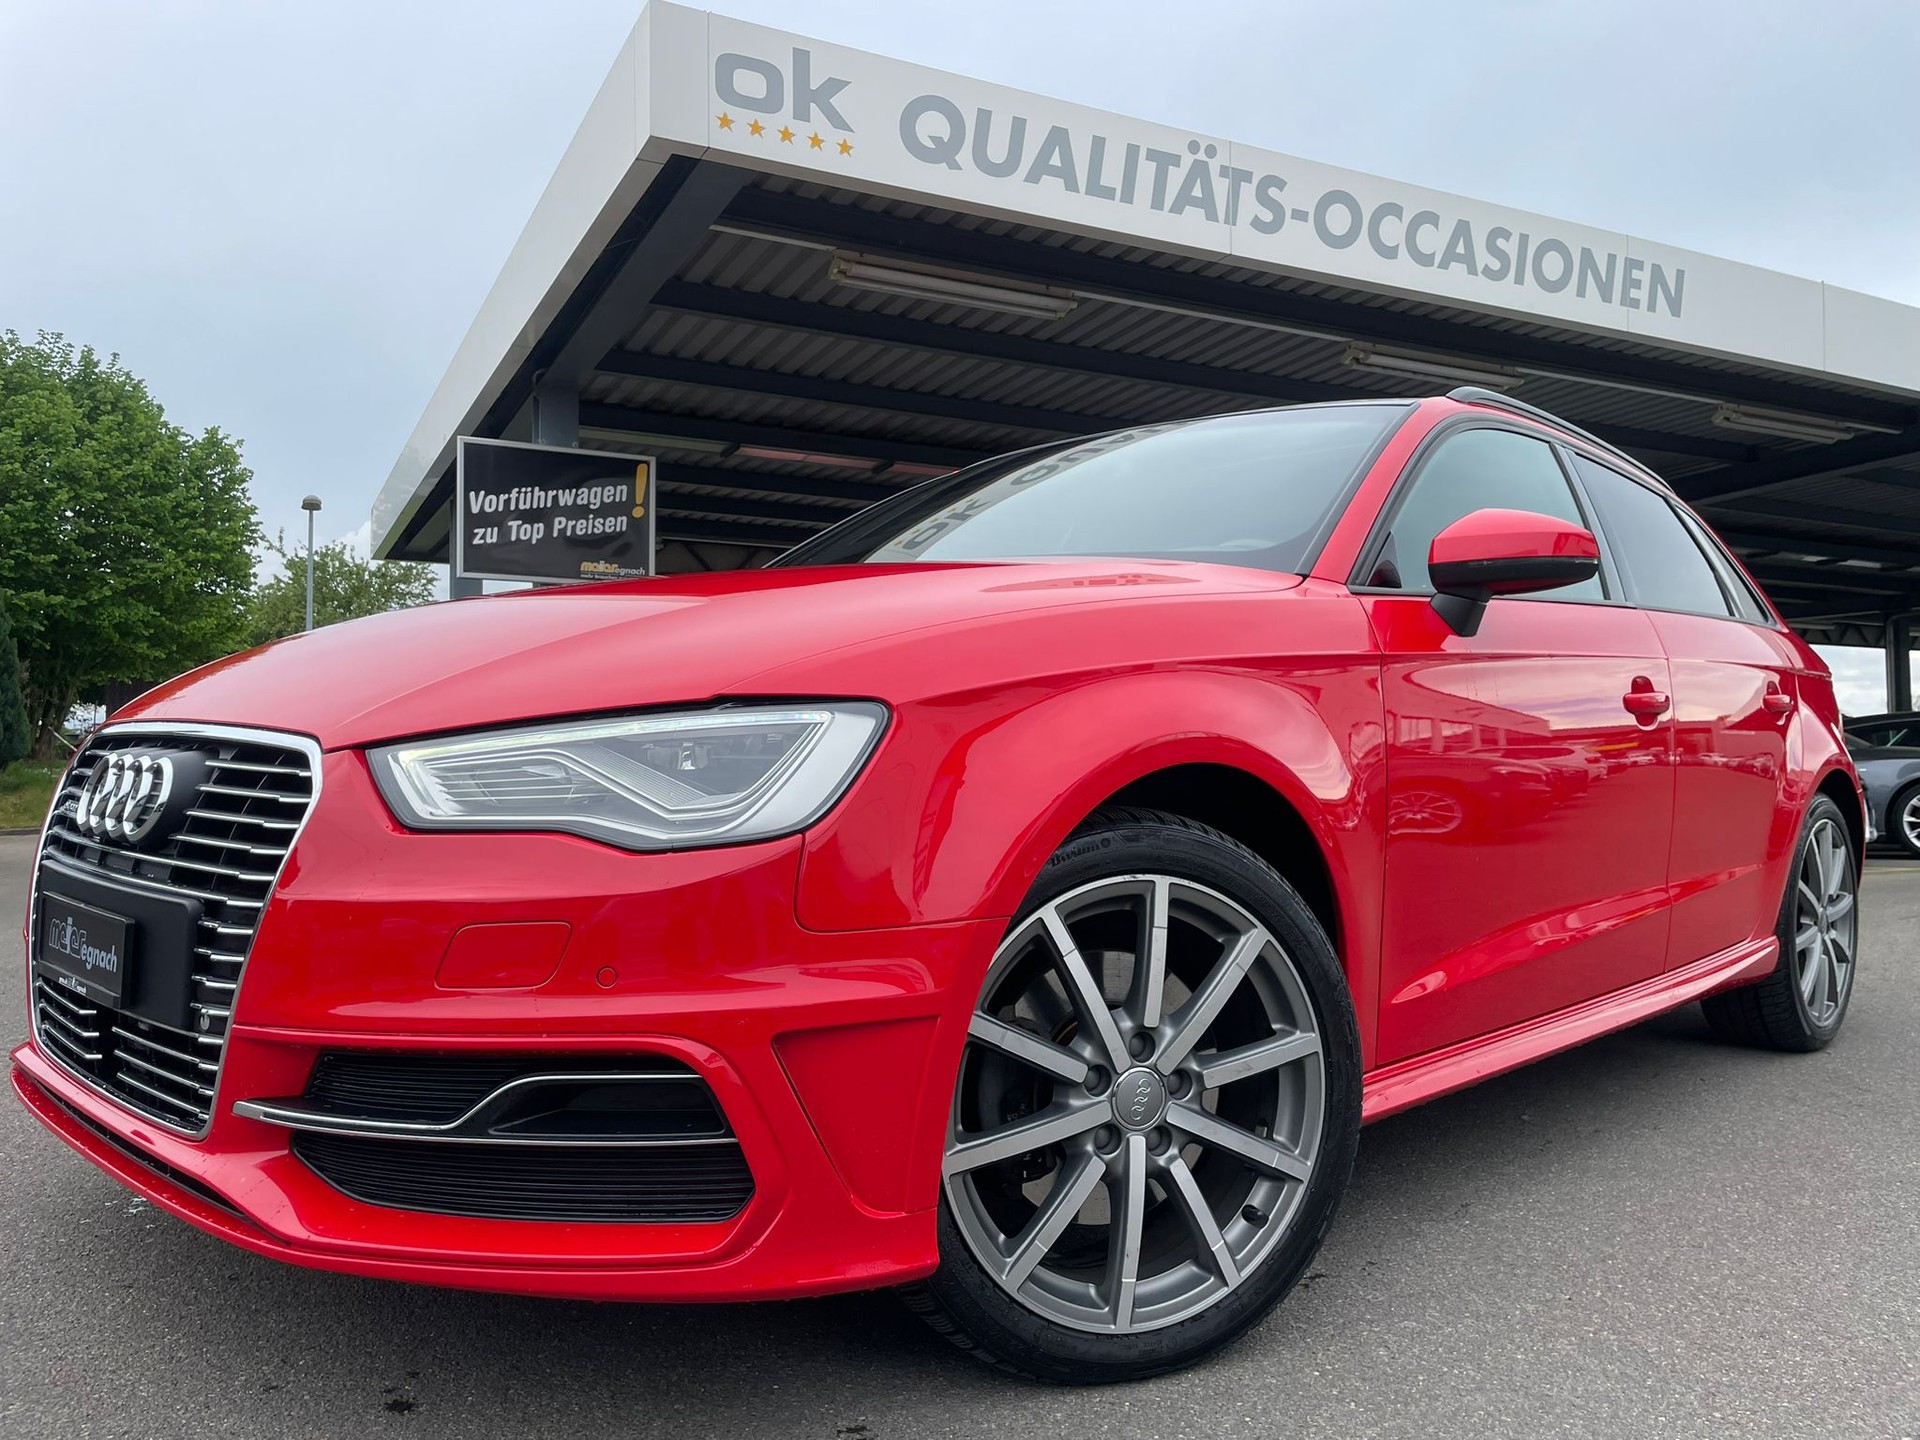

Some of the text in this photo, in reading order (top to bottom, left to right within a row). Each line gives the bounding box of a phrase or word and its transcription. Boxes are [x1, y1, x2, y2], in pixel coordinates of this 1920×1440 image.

[714, 46, 856, 133] ok
[898, 94, 1687, 319] QUALITÄTS-OCCASIONEN
[469, 484, 628, 514] Vorführwagen
[472, 513, 628, 545] zu Top Preisen
[81, 943, 118, 973] egnach
